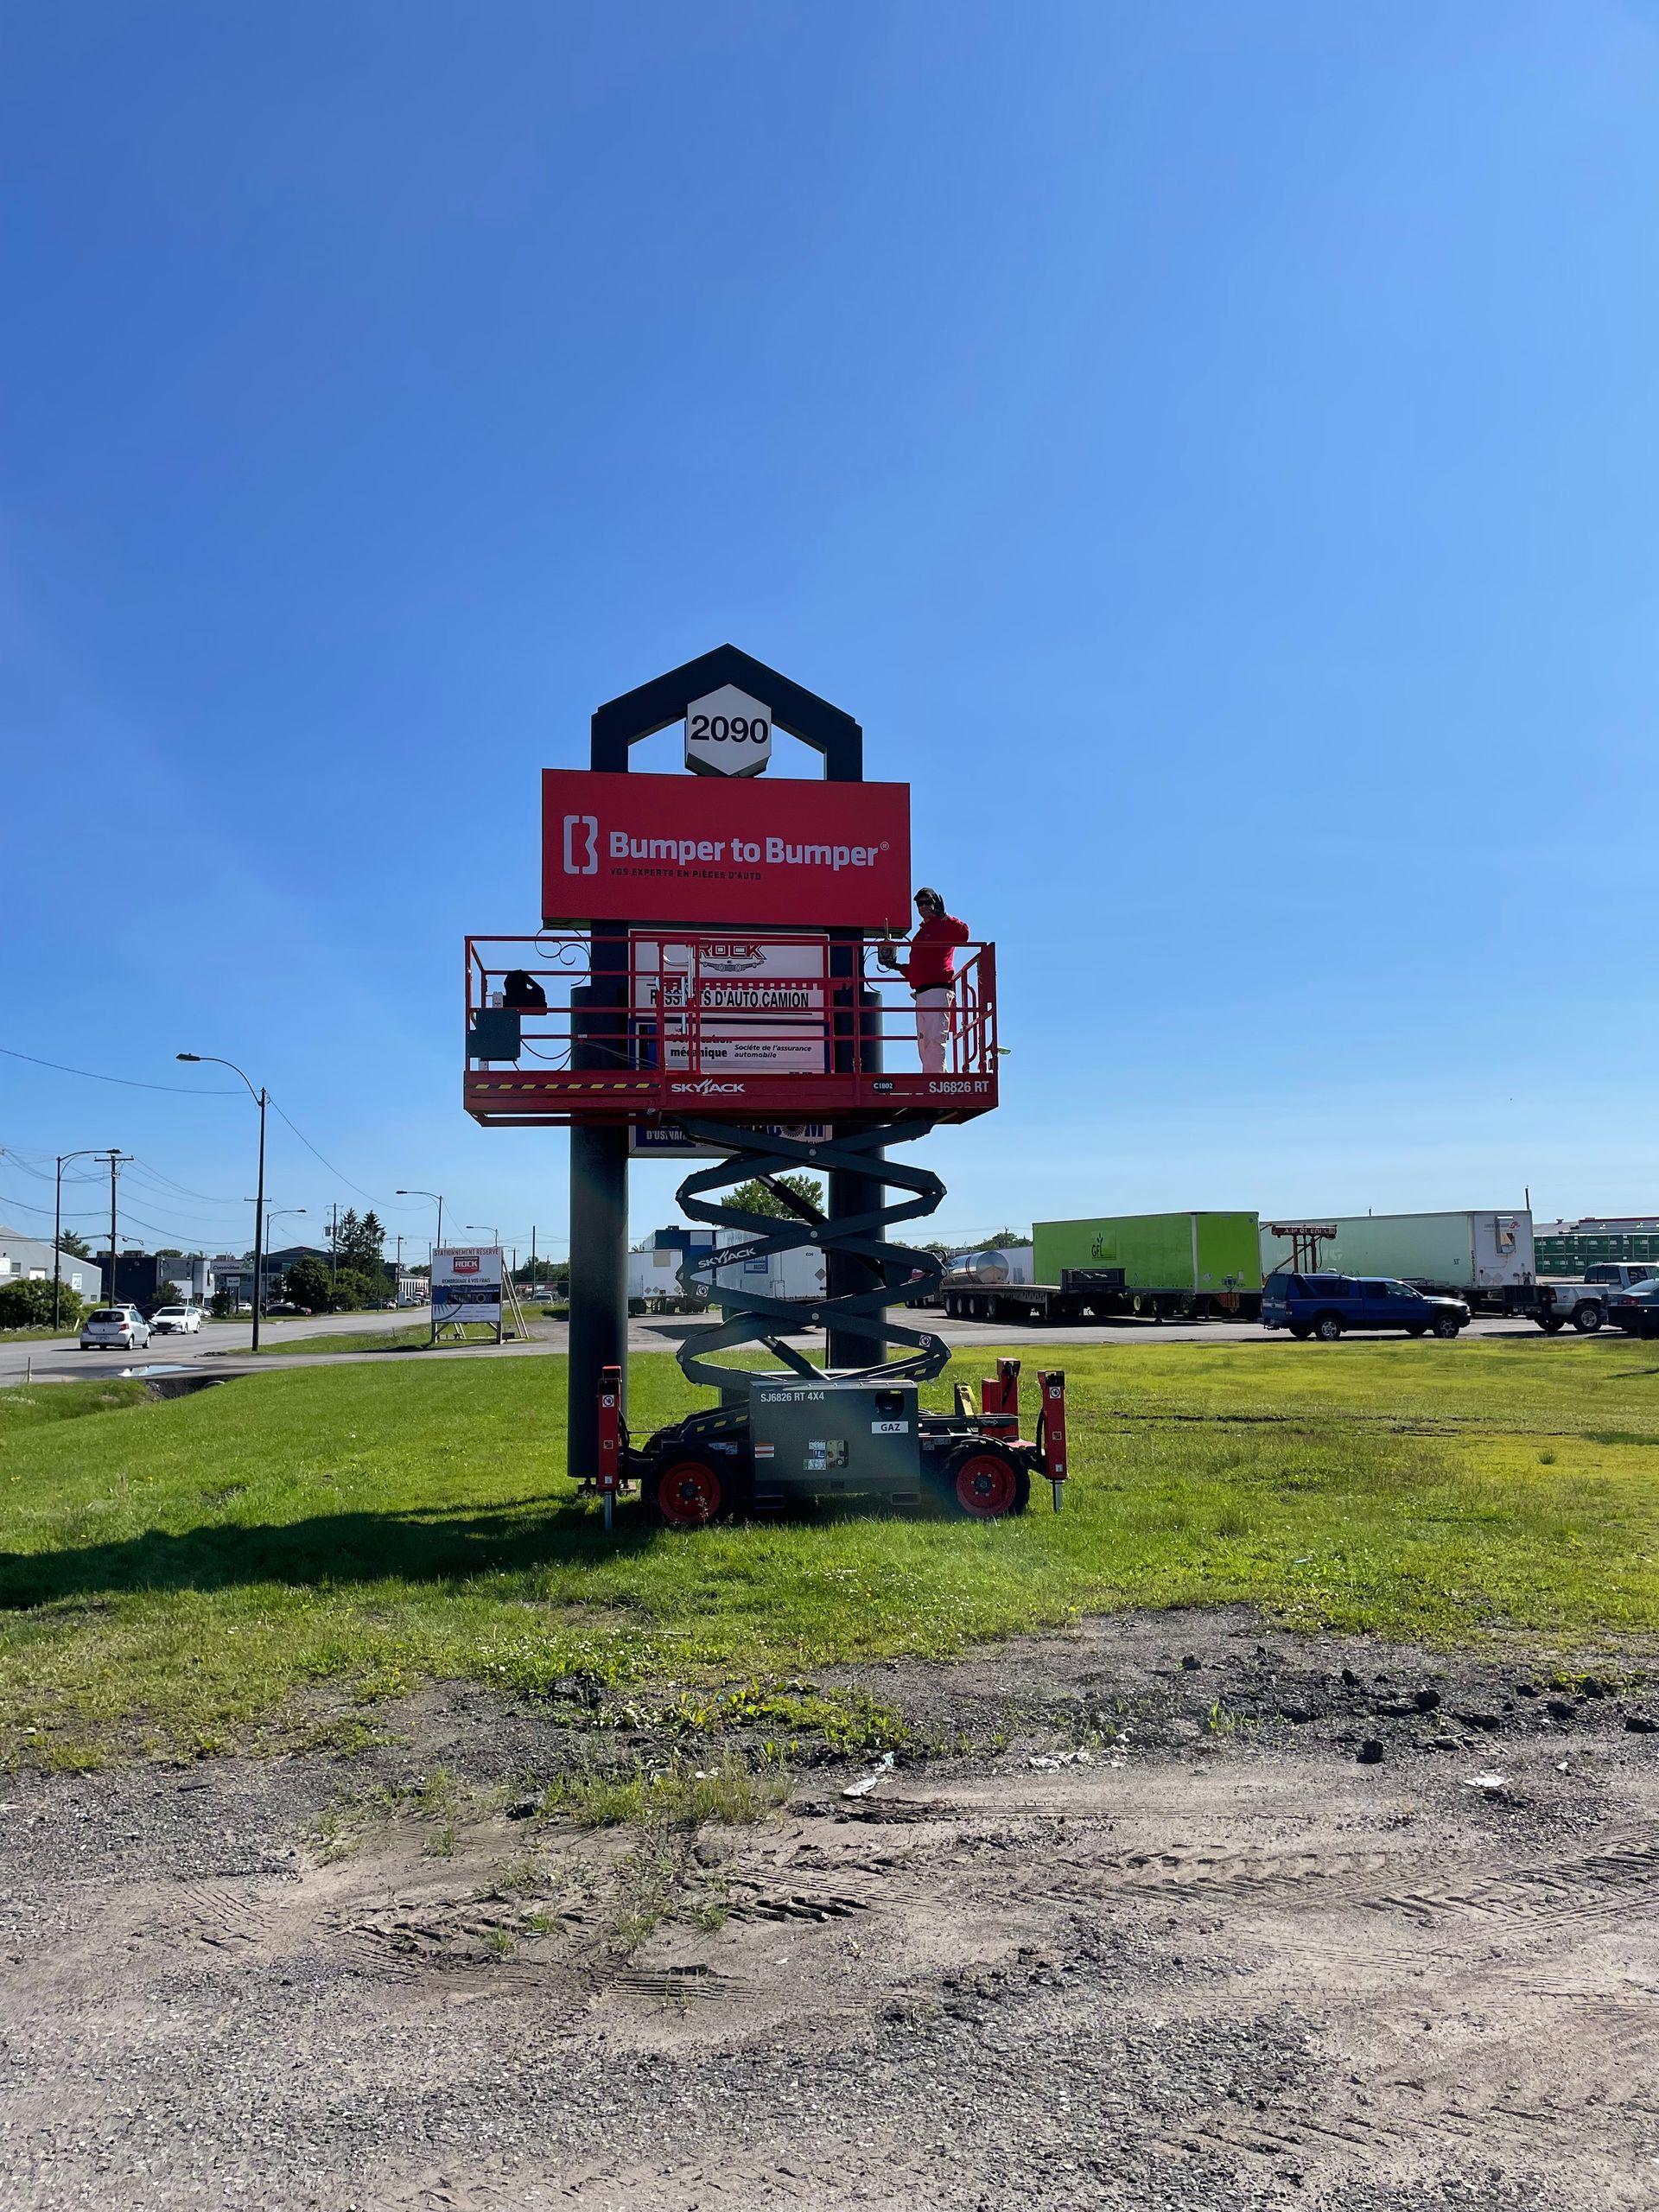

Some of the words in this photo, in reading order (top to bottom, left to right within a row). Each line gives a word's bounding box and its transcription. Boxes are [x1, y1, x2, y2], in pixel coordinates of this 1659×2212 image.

[690, 715, 769, 744] 2090
[609, 831, 726, 866] Bumper
[730, 838, 761, 862] to
[632, 868, 674, 877] EXPERTS
[692, 869, 726, 879] PIÈCES
[728, 871, 761, 880] D'AUTO
[671, 1078, 747, 1095] SKYJACK
[929, 1081, 971, 1093] SJ6826
[974, 1080, 989, 1092] RT
[697, 1247, 757, 1269] SKYJACK
[760, 1392, 792, 1402] SJ6826
[794, 1392, 805, 1402] RT
[807, 1391, 825, 1402] 4X4
[880, 1423, 901, 1432] GAZ
